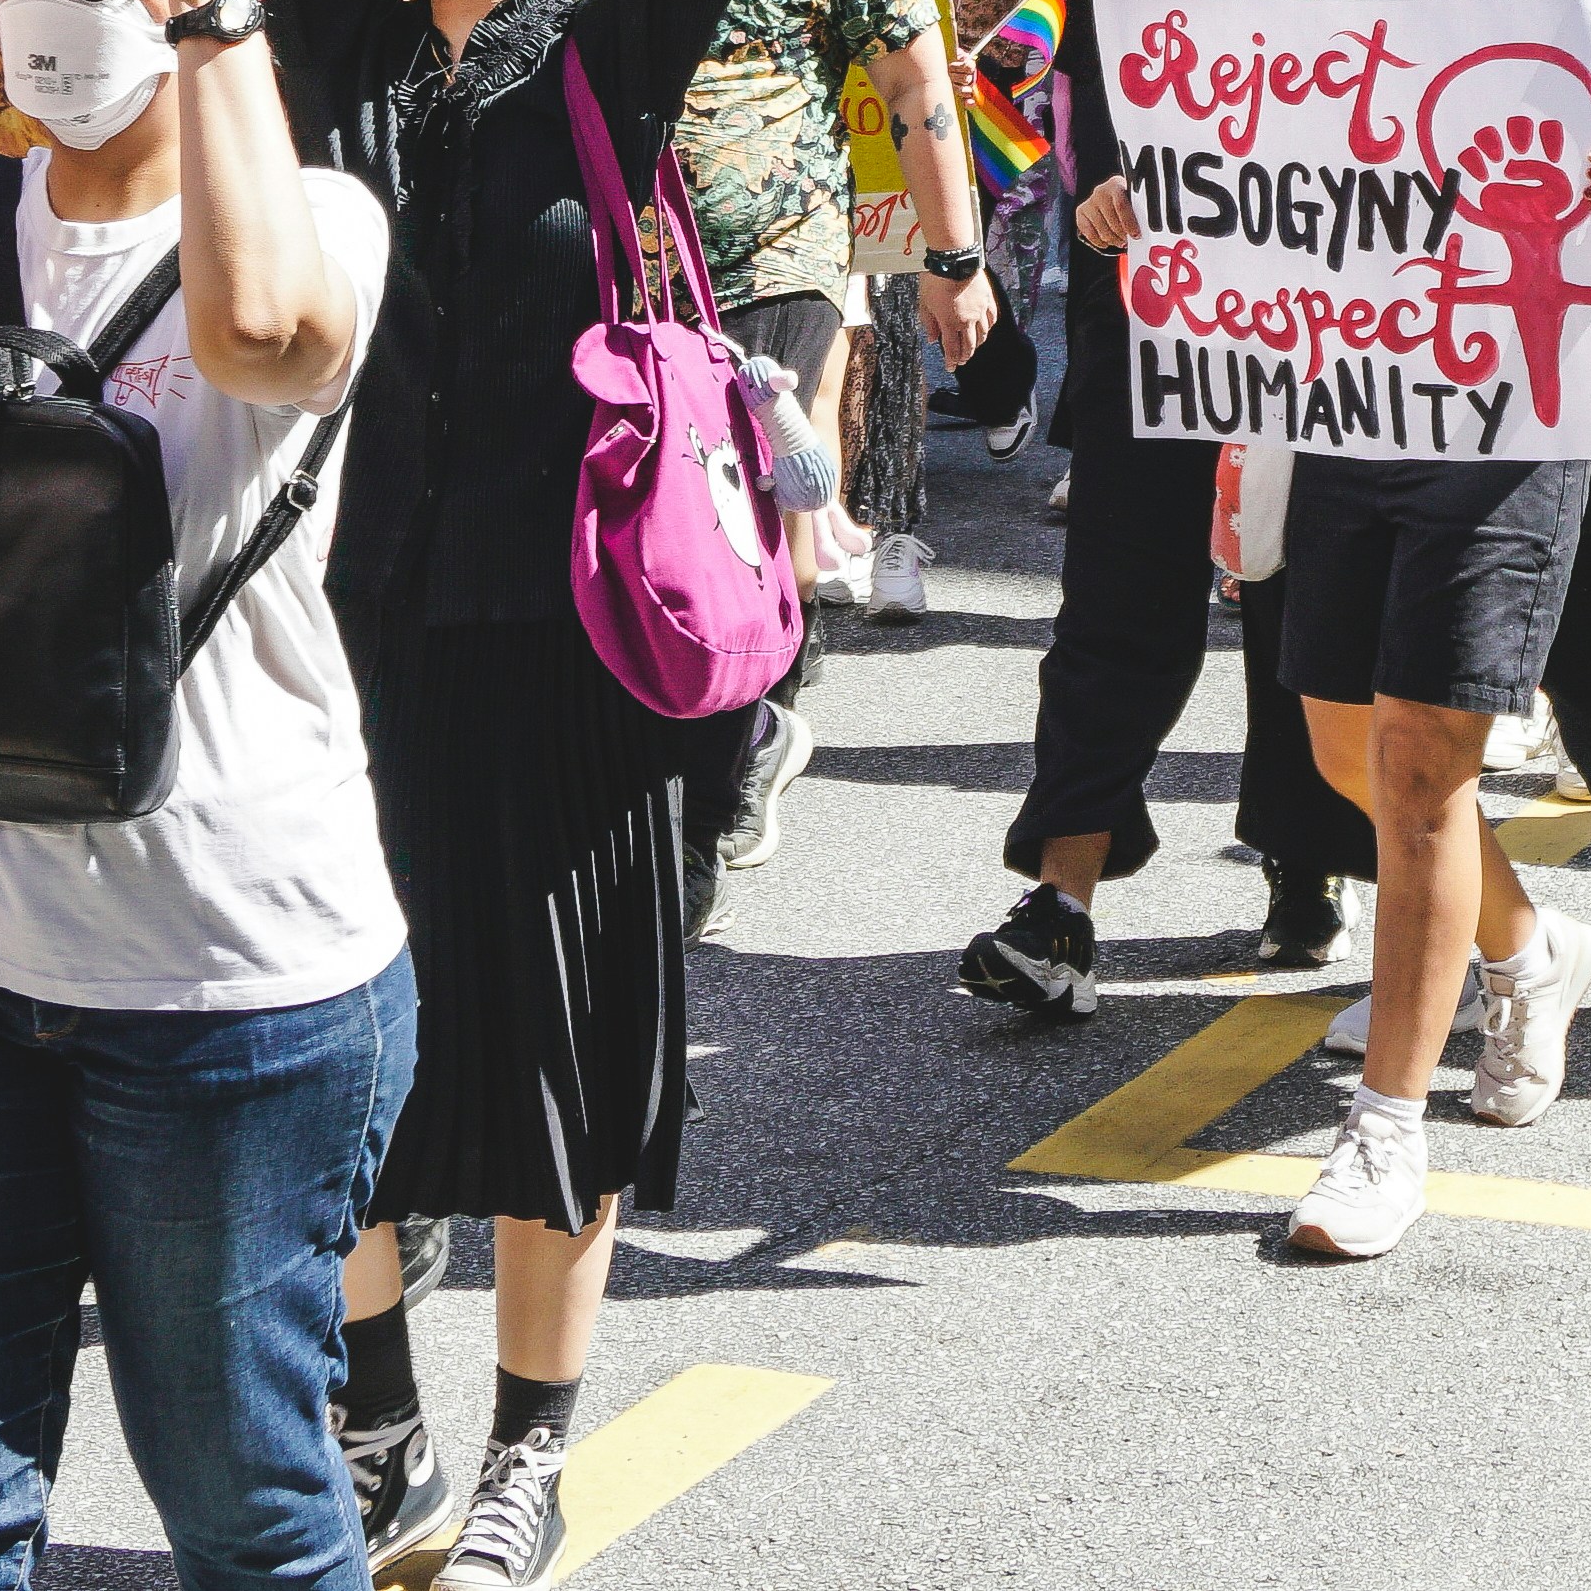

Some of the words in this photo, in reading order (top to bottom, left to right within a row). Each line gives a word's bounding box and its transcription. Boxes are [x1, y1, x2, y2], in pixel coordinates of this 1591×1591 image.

[26, 53, 59, 72] 3M
[1118, 8, 1422, 165] Reject
[1119, 139, 1462, 273] MISOGYNY
[1130, 232, 1500, 387] Respect
[1139, 337, 1514, 456] HUMANITY
